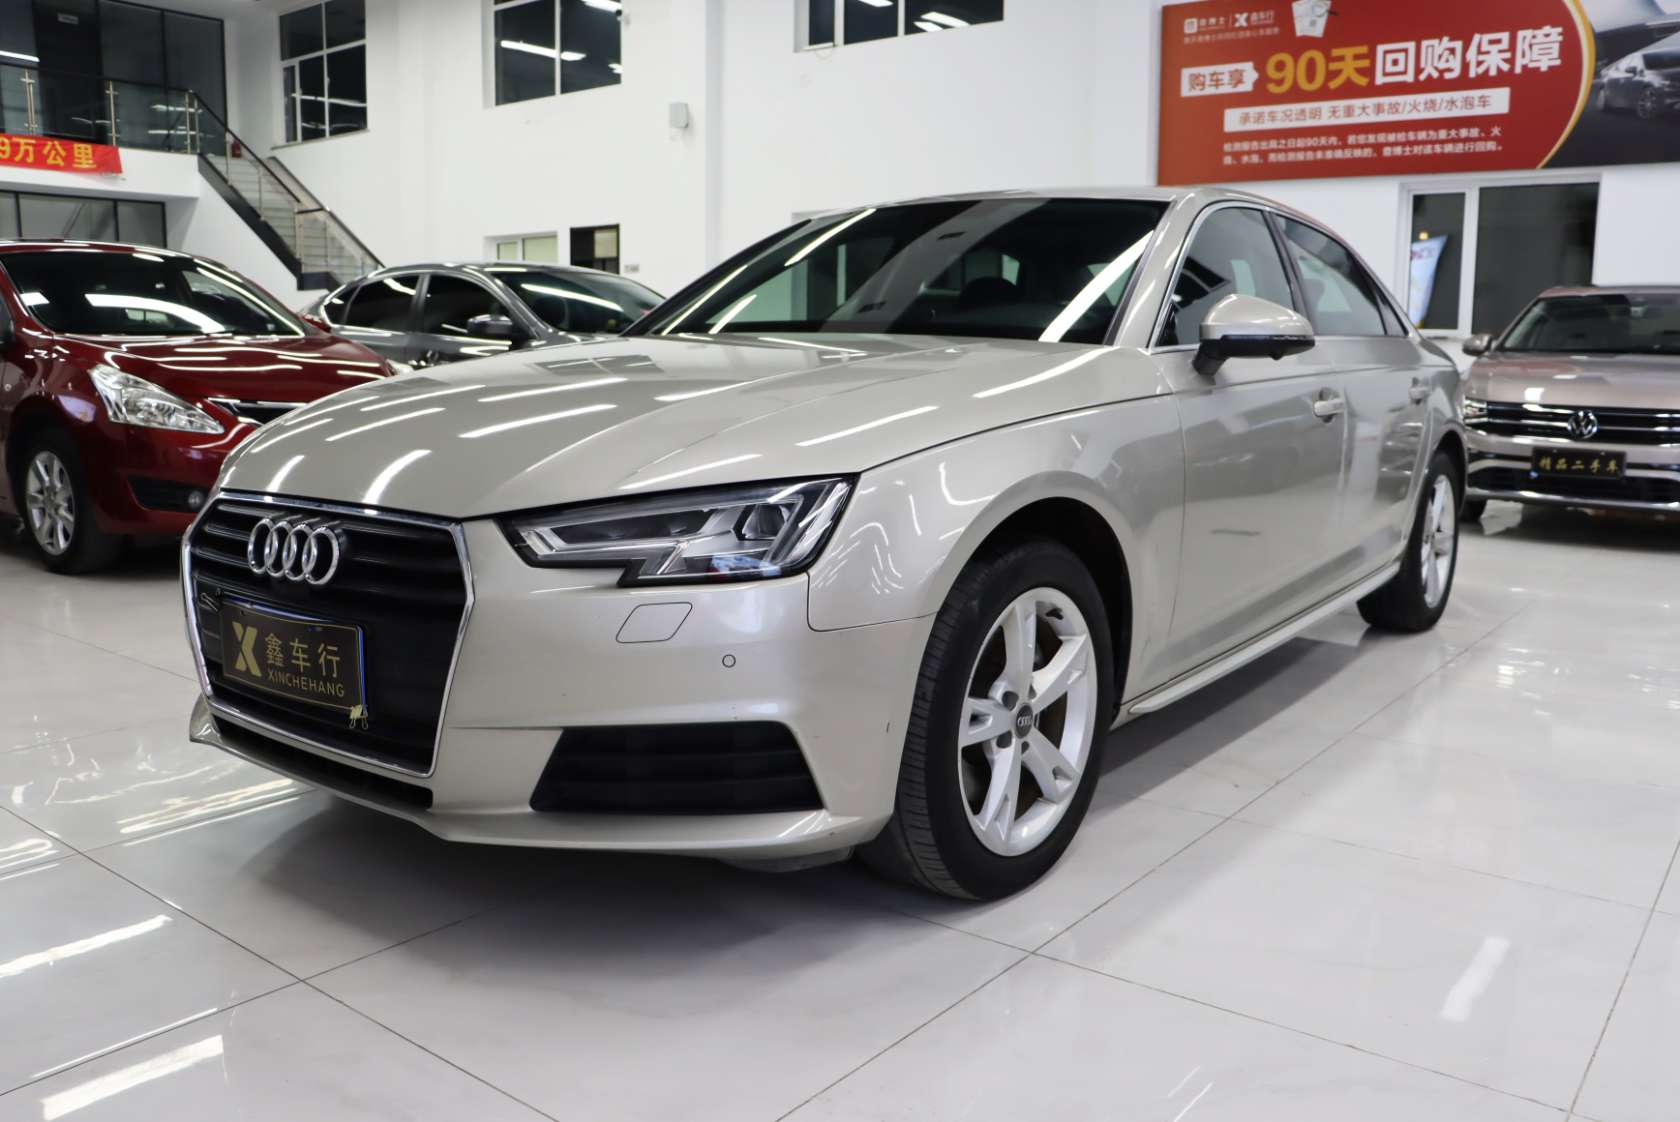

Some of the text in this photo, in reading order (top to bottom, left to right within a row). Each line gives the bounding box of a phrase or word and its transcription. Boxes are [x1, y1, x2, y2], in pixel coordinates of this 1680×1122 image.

[1187, 69, 1245, 92] 购车享
[1238, 107, 1323, 126] 承诺车况透明
[264, 632, 341, 679] 鑫车行
[267, 667, 345, 698] XINCHEHANG
